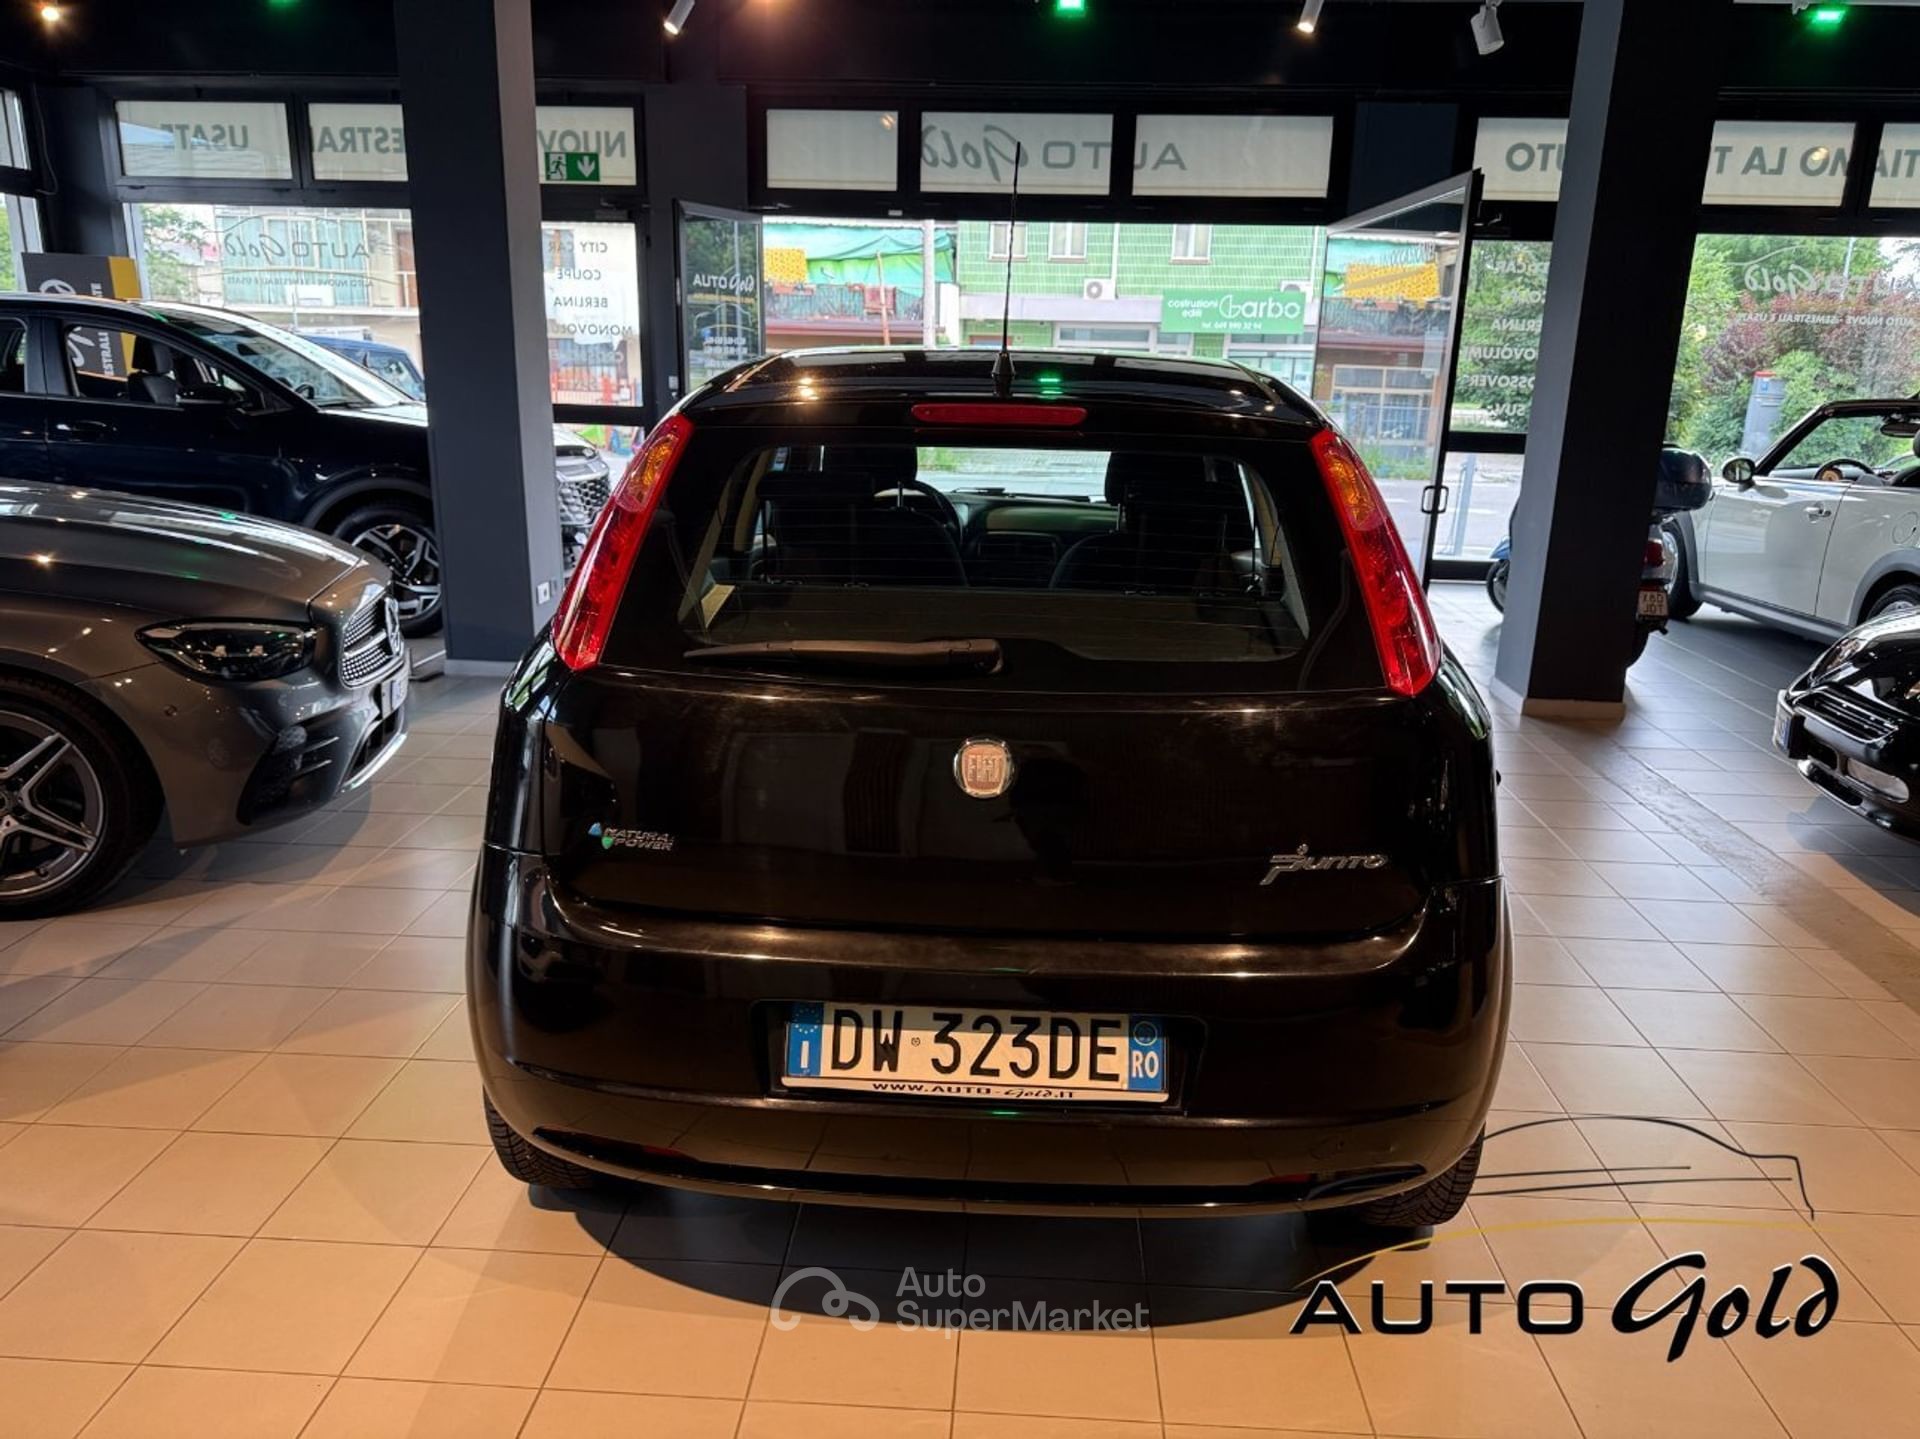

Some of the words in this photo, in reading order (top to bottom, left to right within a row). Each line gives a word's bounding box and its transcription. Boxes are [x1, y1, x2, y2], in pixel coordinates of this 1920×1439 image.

[693, 273, 728, 289] AUTO
[1167, 299, 1218, 309] costruzioni
[614, 838, 674, 851] POWER
[831, 1009, 903, 1072] DW
[931, 1012, 1122, 1082] 323DE
[1131, 1050, 1159, 1079] RO
